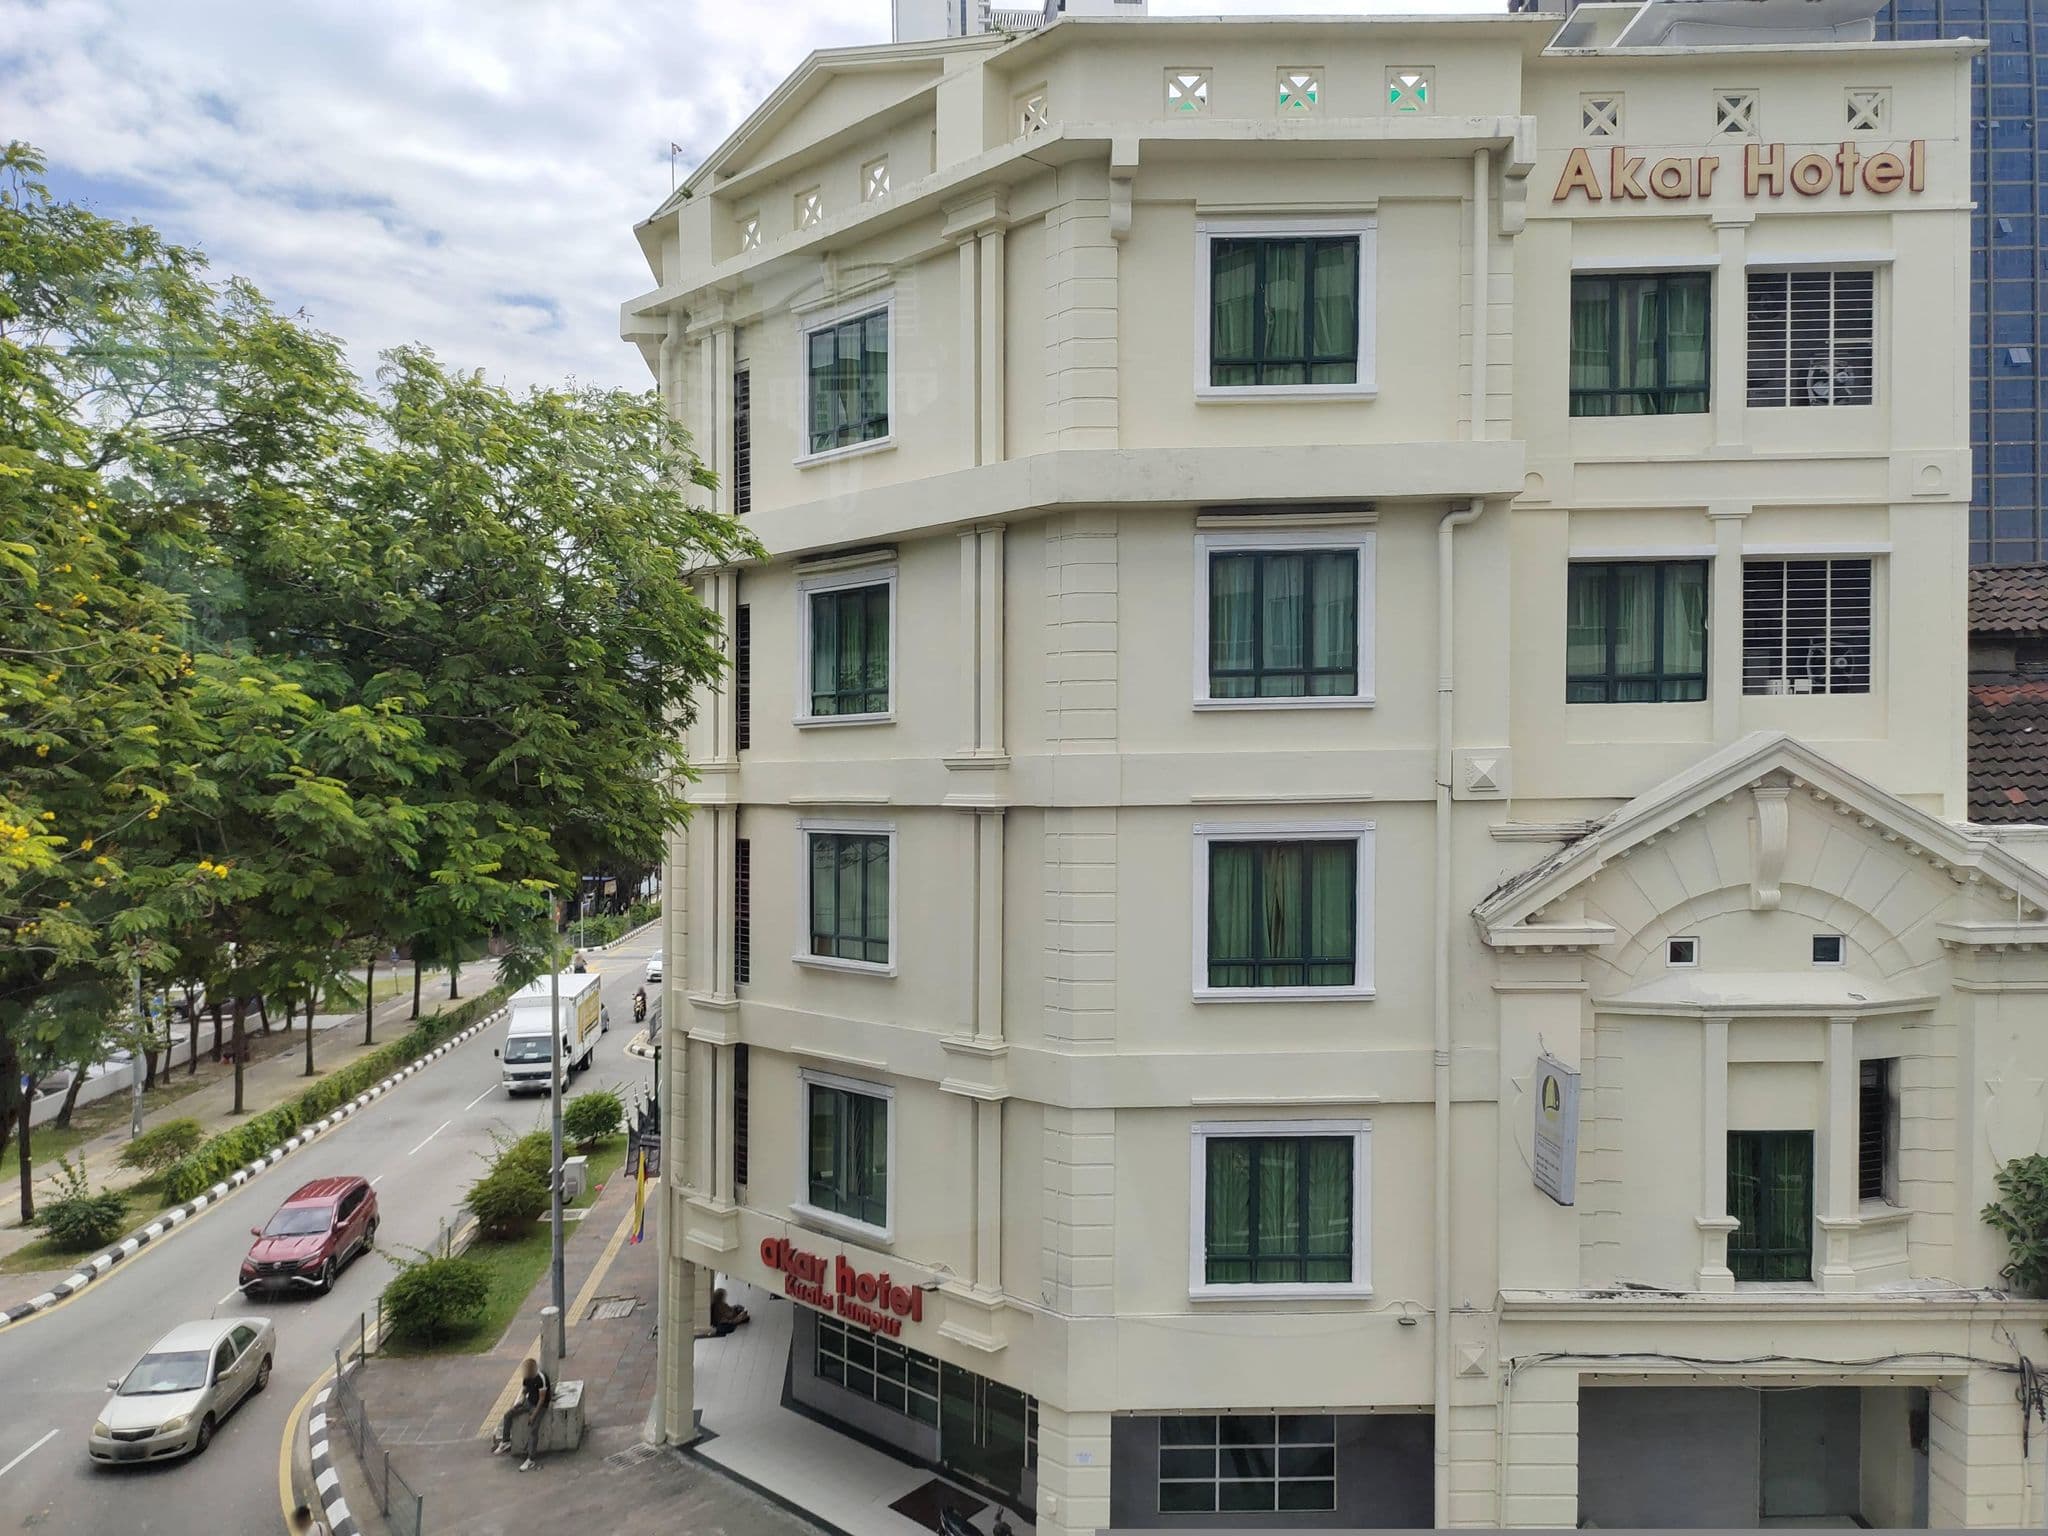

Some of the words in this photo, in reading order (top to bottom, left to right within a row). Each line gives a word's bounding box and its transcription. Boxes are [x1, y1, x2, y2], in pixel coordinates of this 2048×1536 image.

[1553, 146, 1720, 201] Akar
[1744, 140, 1926, 197] Hotel
[761, 1237, 828, 1285] akar
[835, 1254, 923, 1322] hotel
[785, 1274, 834, 1310] Kuala
[837, 1295, 903, 1337] Lumpur
